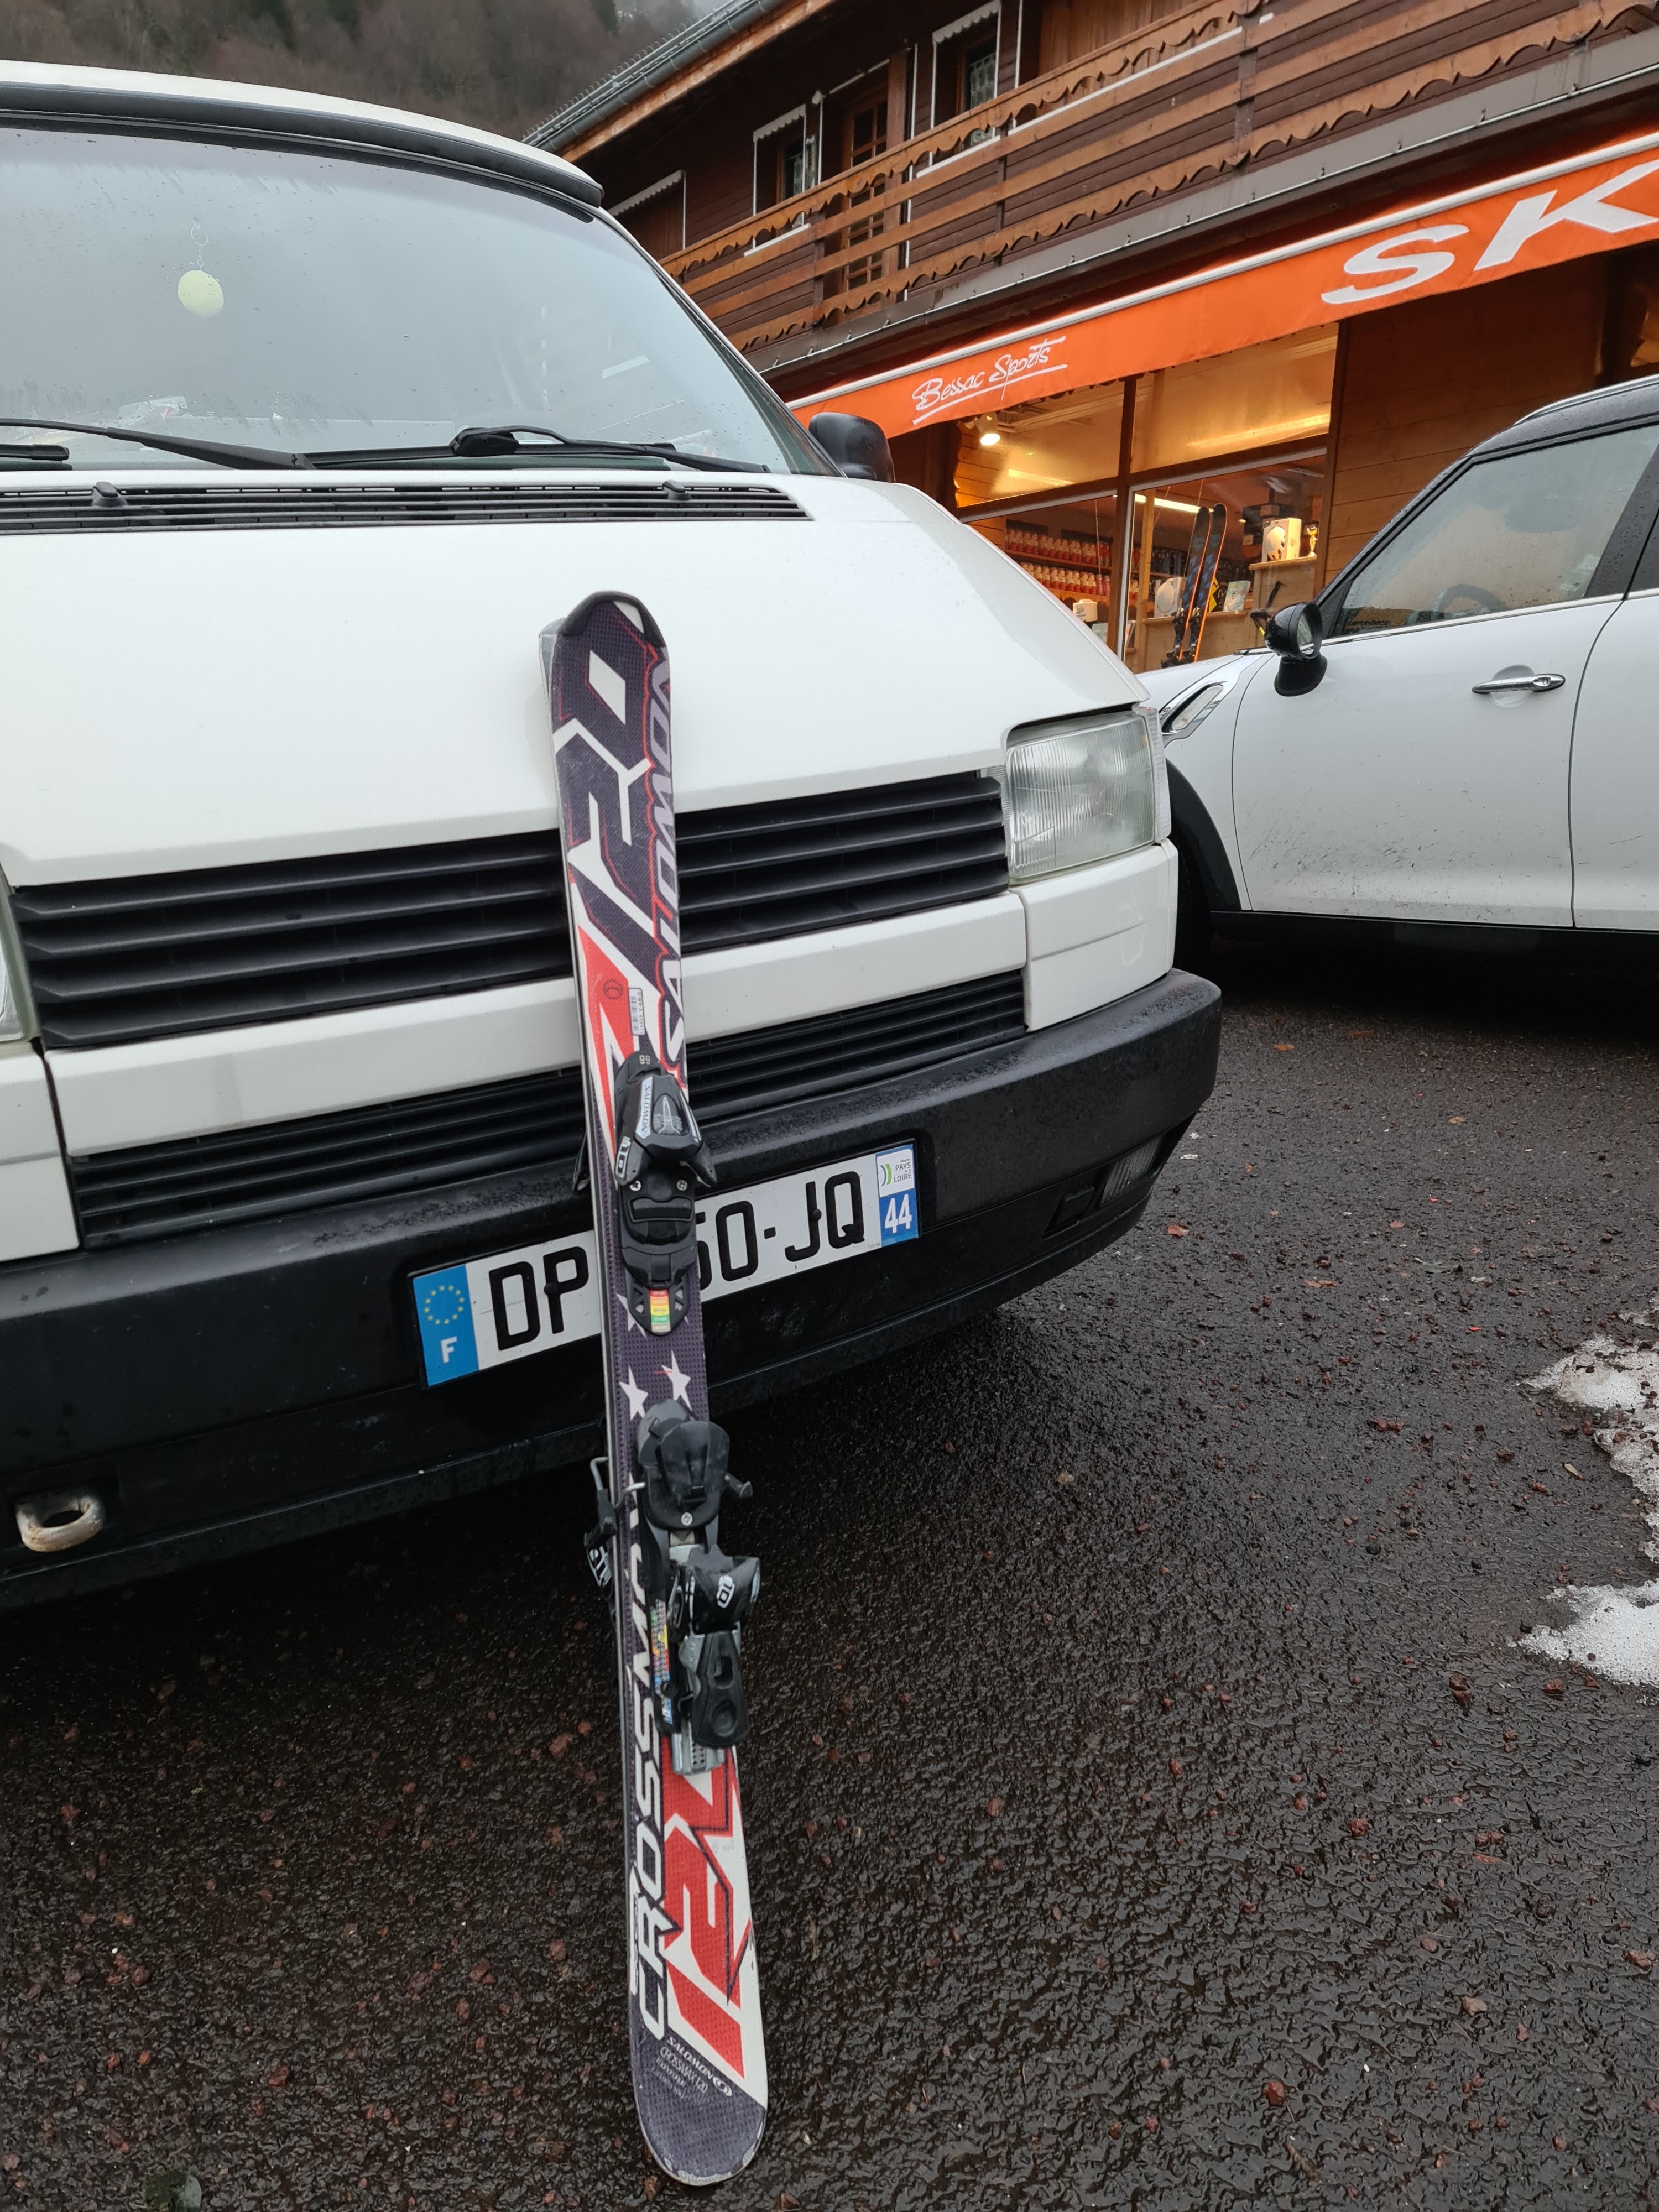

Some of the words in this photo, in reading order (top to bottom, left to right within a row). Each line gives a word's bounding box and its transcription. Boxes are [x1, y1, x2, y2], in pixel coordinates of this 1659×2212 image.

[912, 371, 985, 411] Bessac
[988, 336, 1066, 400] Sports
[641, 1085, 651, 1133] SALOMON
[894, 1172, 911, 1182] LOIRE
[895, 1162, 911, 1171] PAYS
[885, 1193, 912, 1234] 44
[441, 1336, 457, 1363] F
[718, 1583, 733, 1604] 10
[660, 2047, 697, 2083] CROSSMAX
[667, 2037, 713, 2079] SALOMON
